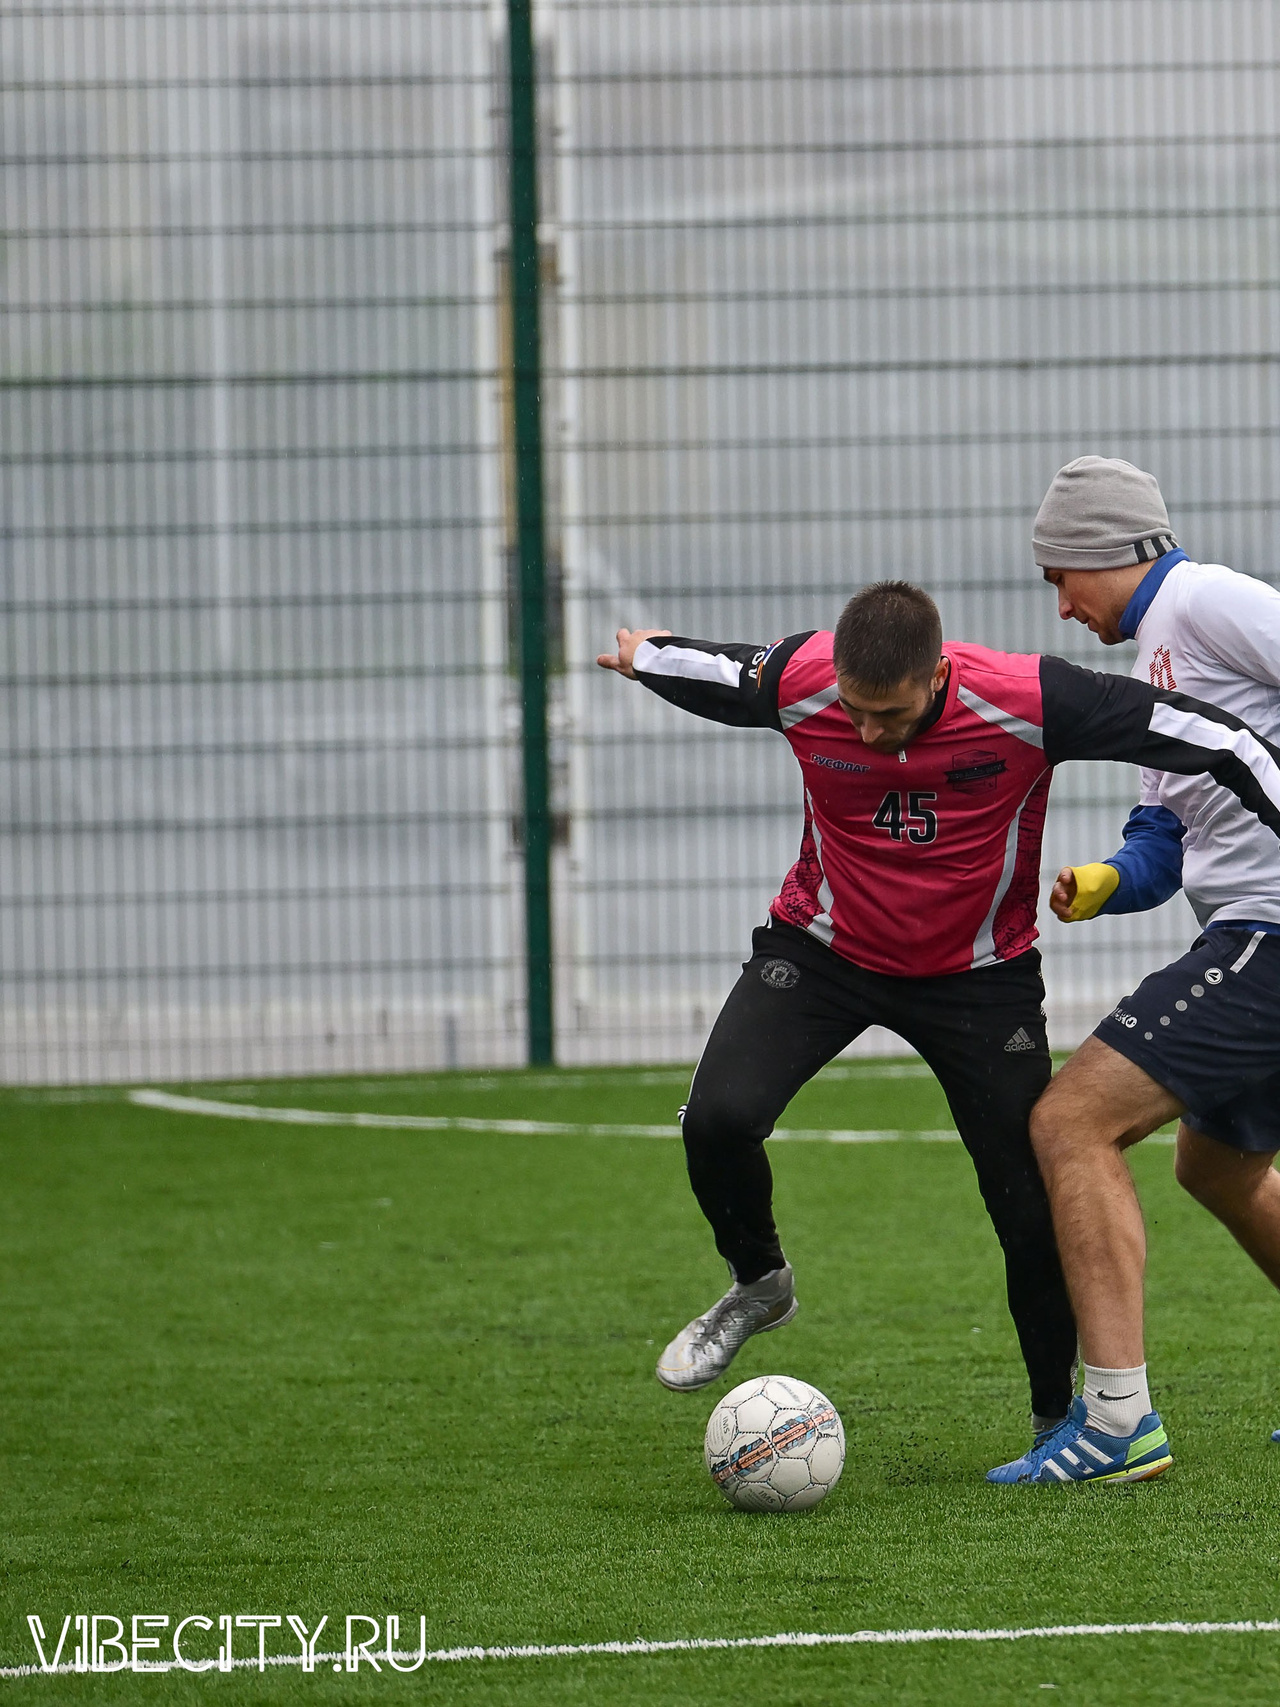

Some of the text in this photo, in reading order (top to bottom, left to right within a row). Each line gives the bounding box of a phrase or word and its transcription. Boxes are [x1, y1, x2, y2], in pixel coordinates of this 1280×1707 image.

[810, 753, 870, 773] РУСФЛАГ
[872, 791, 938, 844] 45
[1003, 1041, 1036, 1052] adidas
